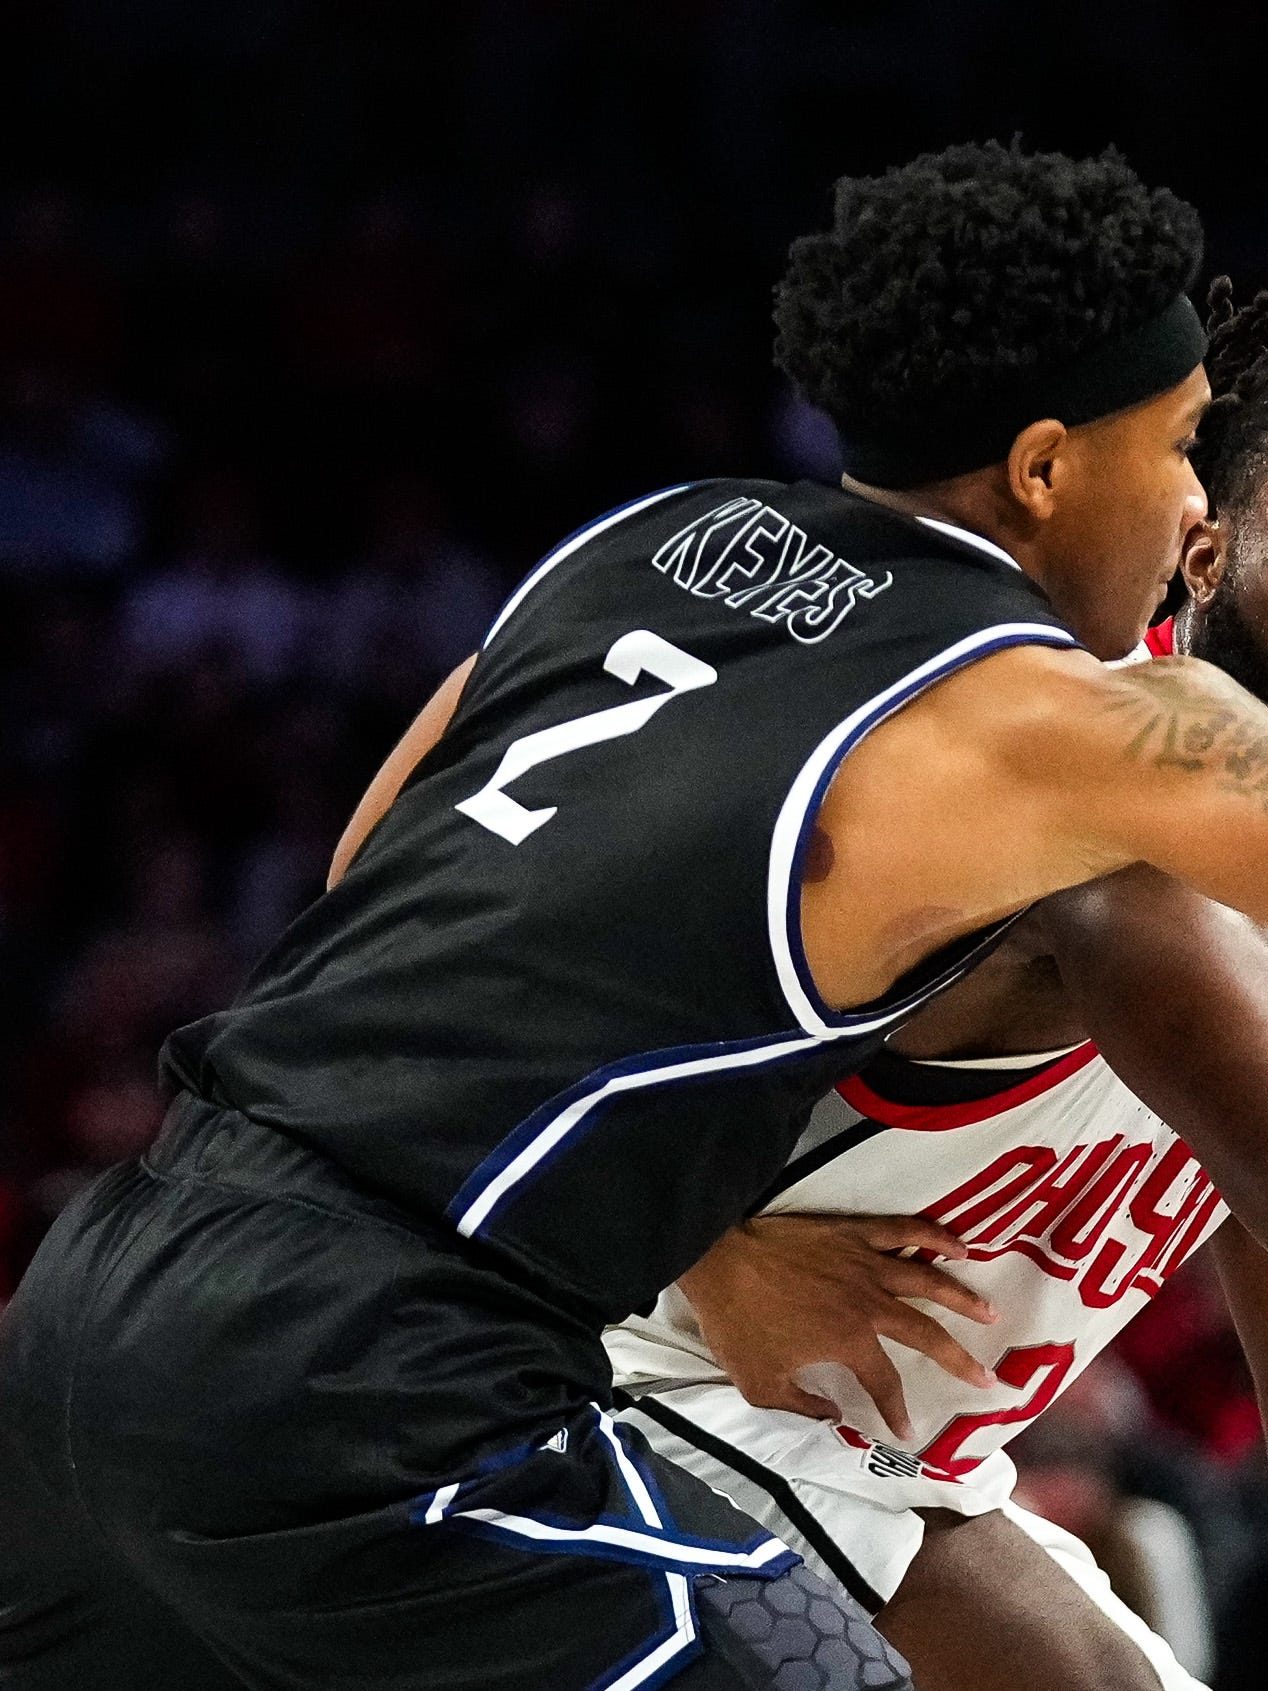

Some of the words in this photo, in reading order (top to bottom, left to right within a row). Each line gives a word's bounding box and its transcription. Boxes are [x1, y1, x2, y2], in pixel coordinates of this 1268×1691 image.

[652, 496, 893, 644] KEYES
[454, 629, 718, 846] 2
[918, 1340, 1077, 1476] 2
